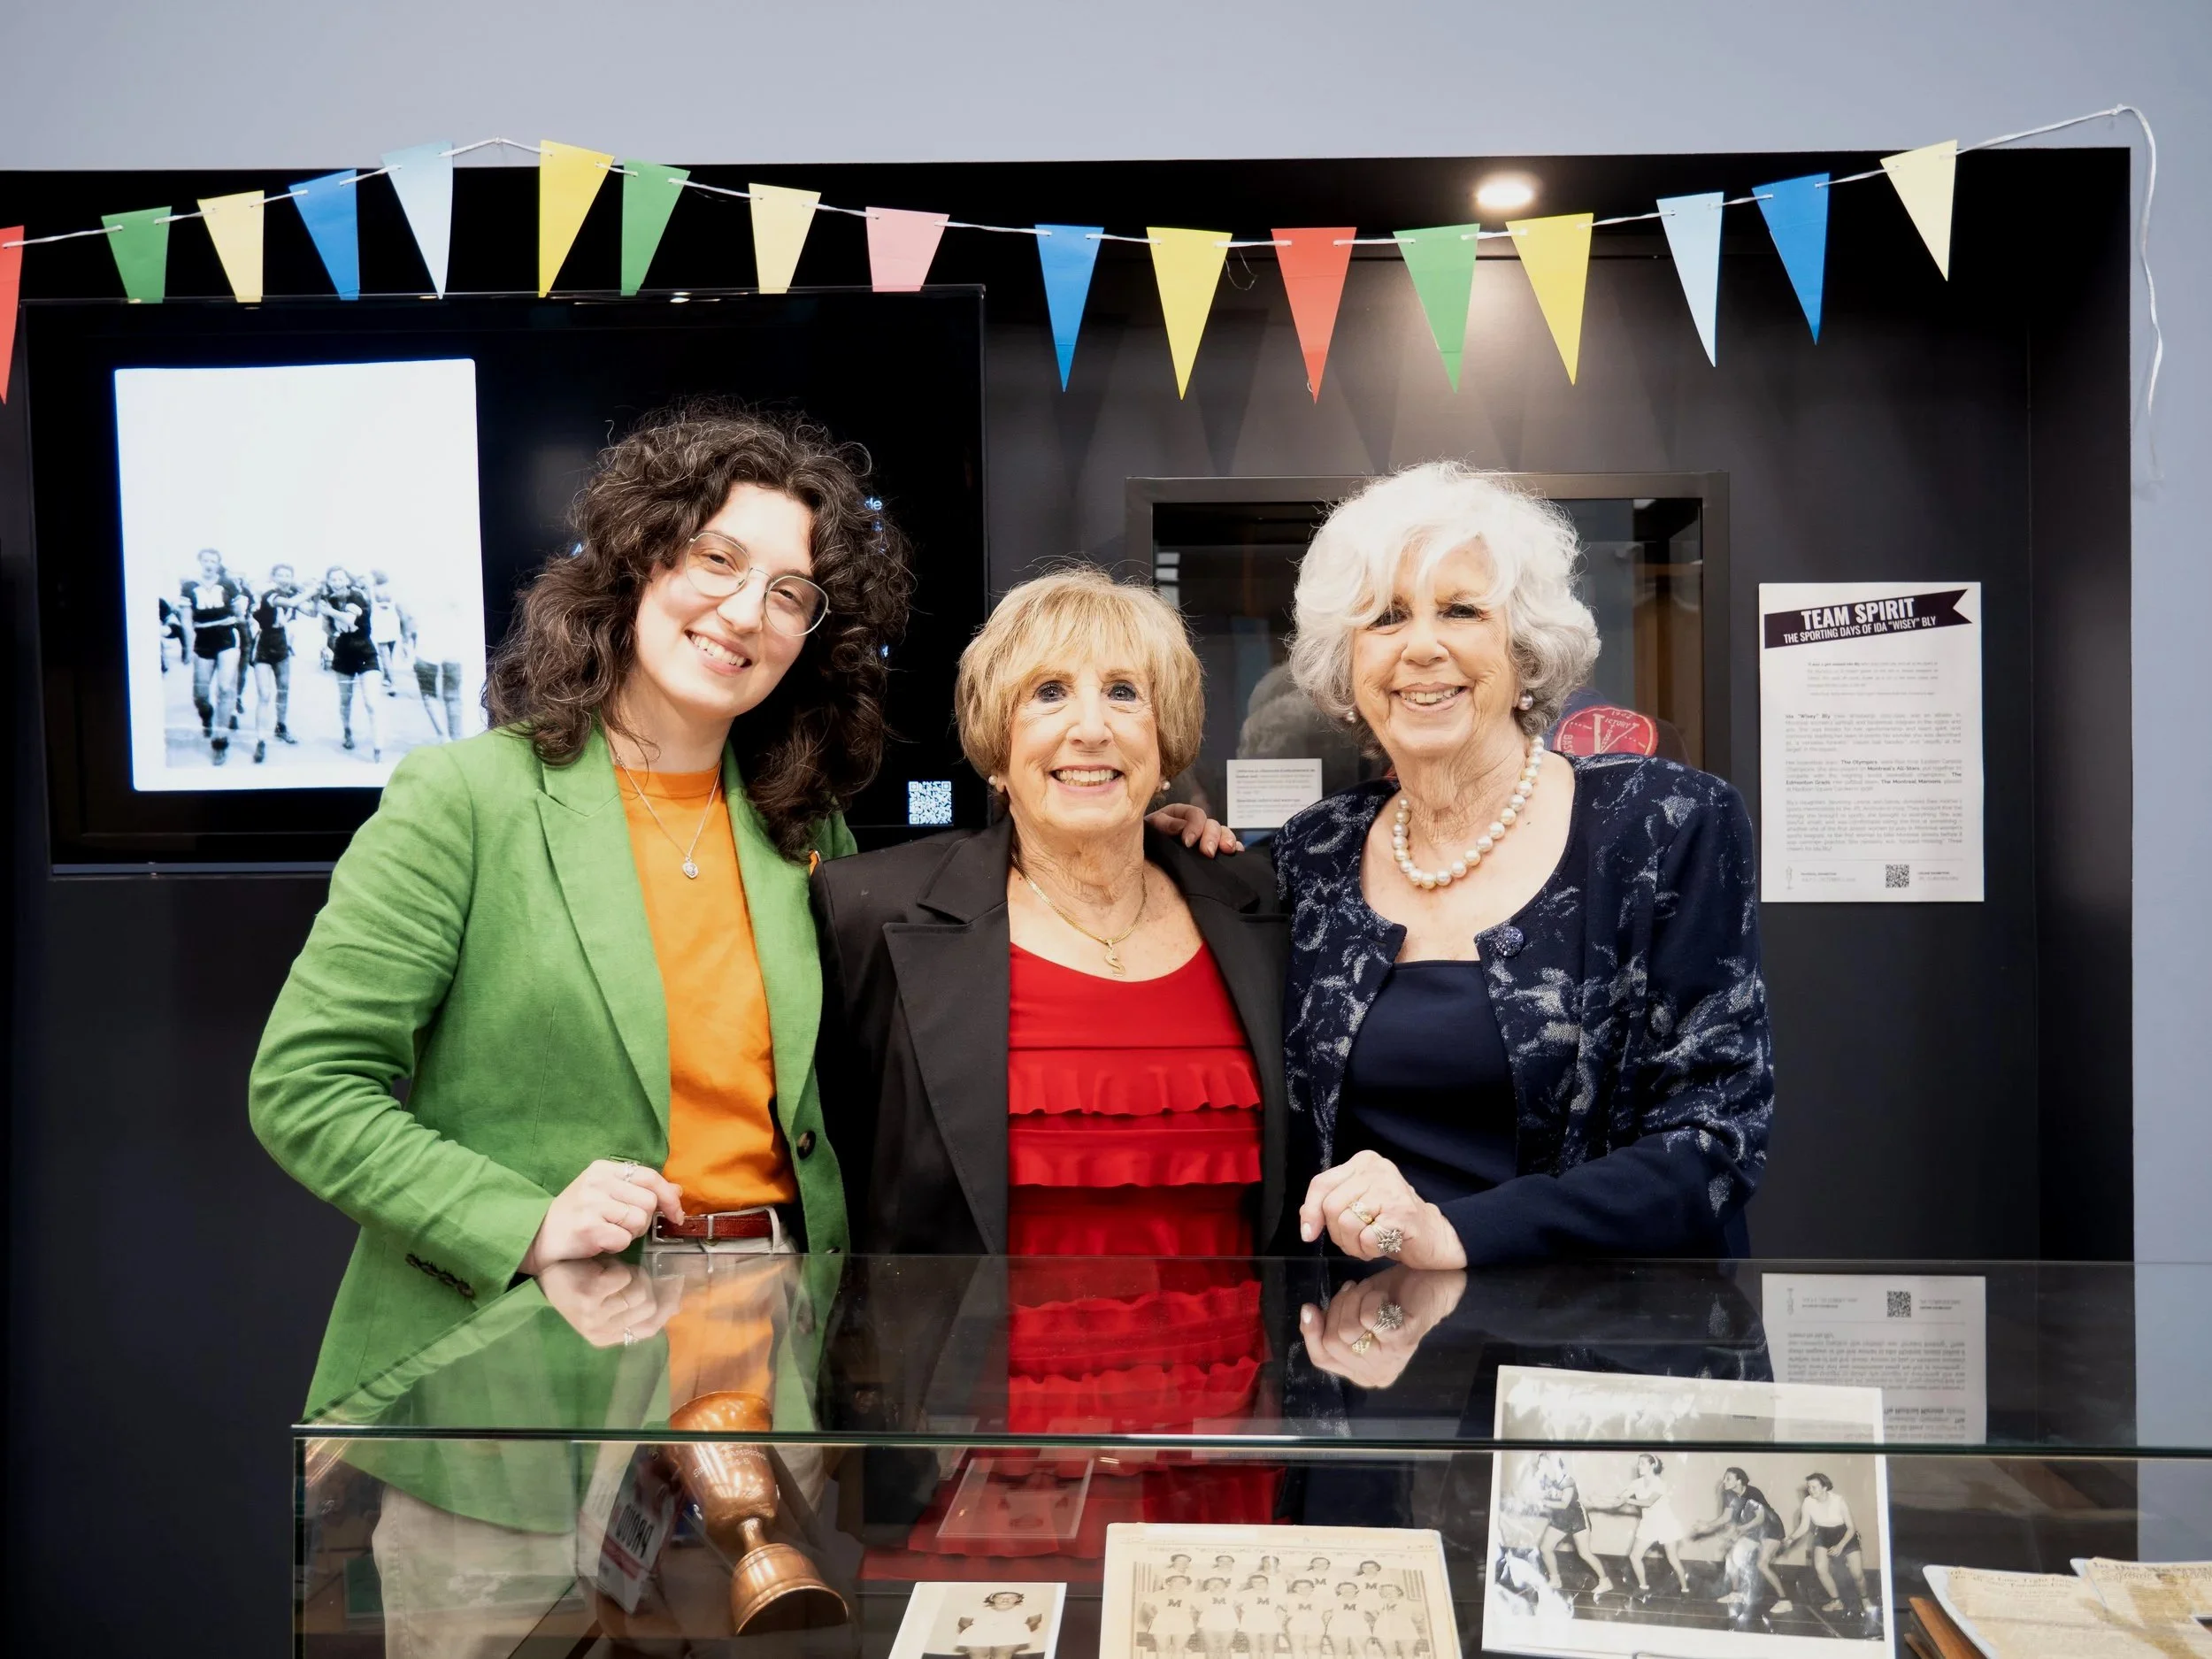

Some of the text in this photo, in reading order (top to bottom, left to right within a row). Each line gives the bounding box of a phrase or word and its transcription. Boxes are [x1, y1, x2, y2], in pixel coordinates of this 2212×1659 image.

[1801, 597, 1915, 631] TEAM SPIRIT
[1784, 616, 1937, 644] THE SPORTING DAYS OF IDA "WISEY" BLY
